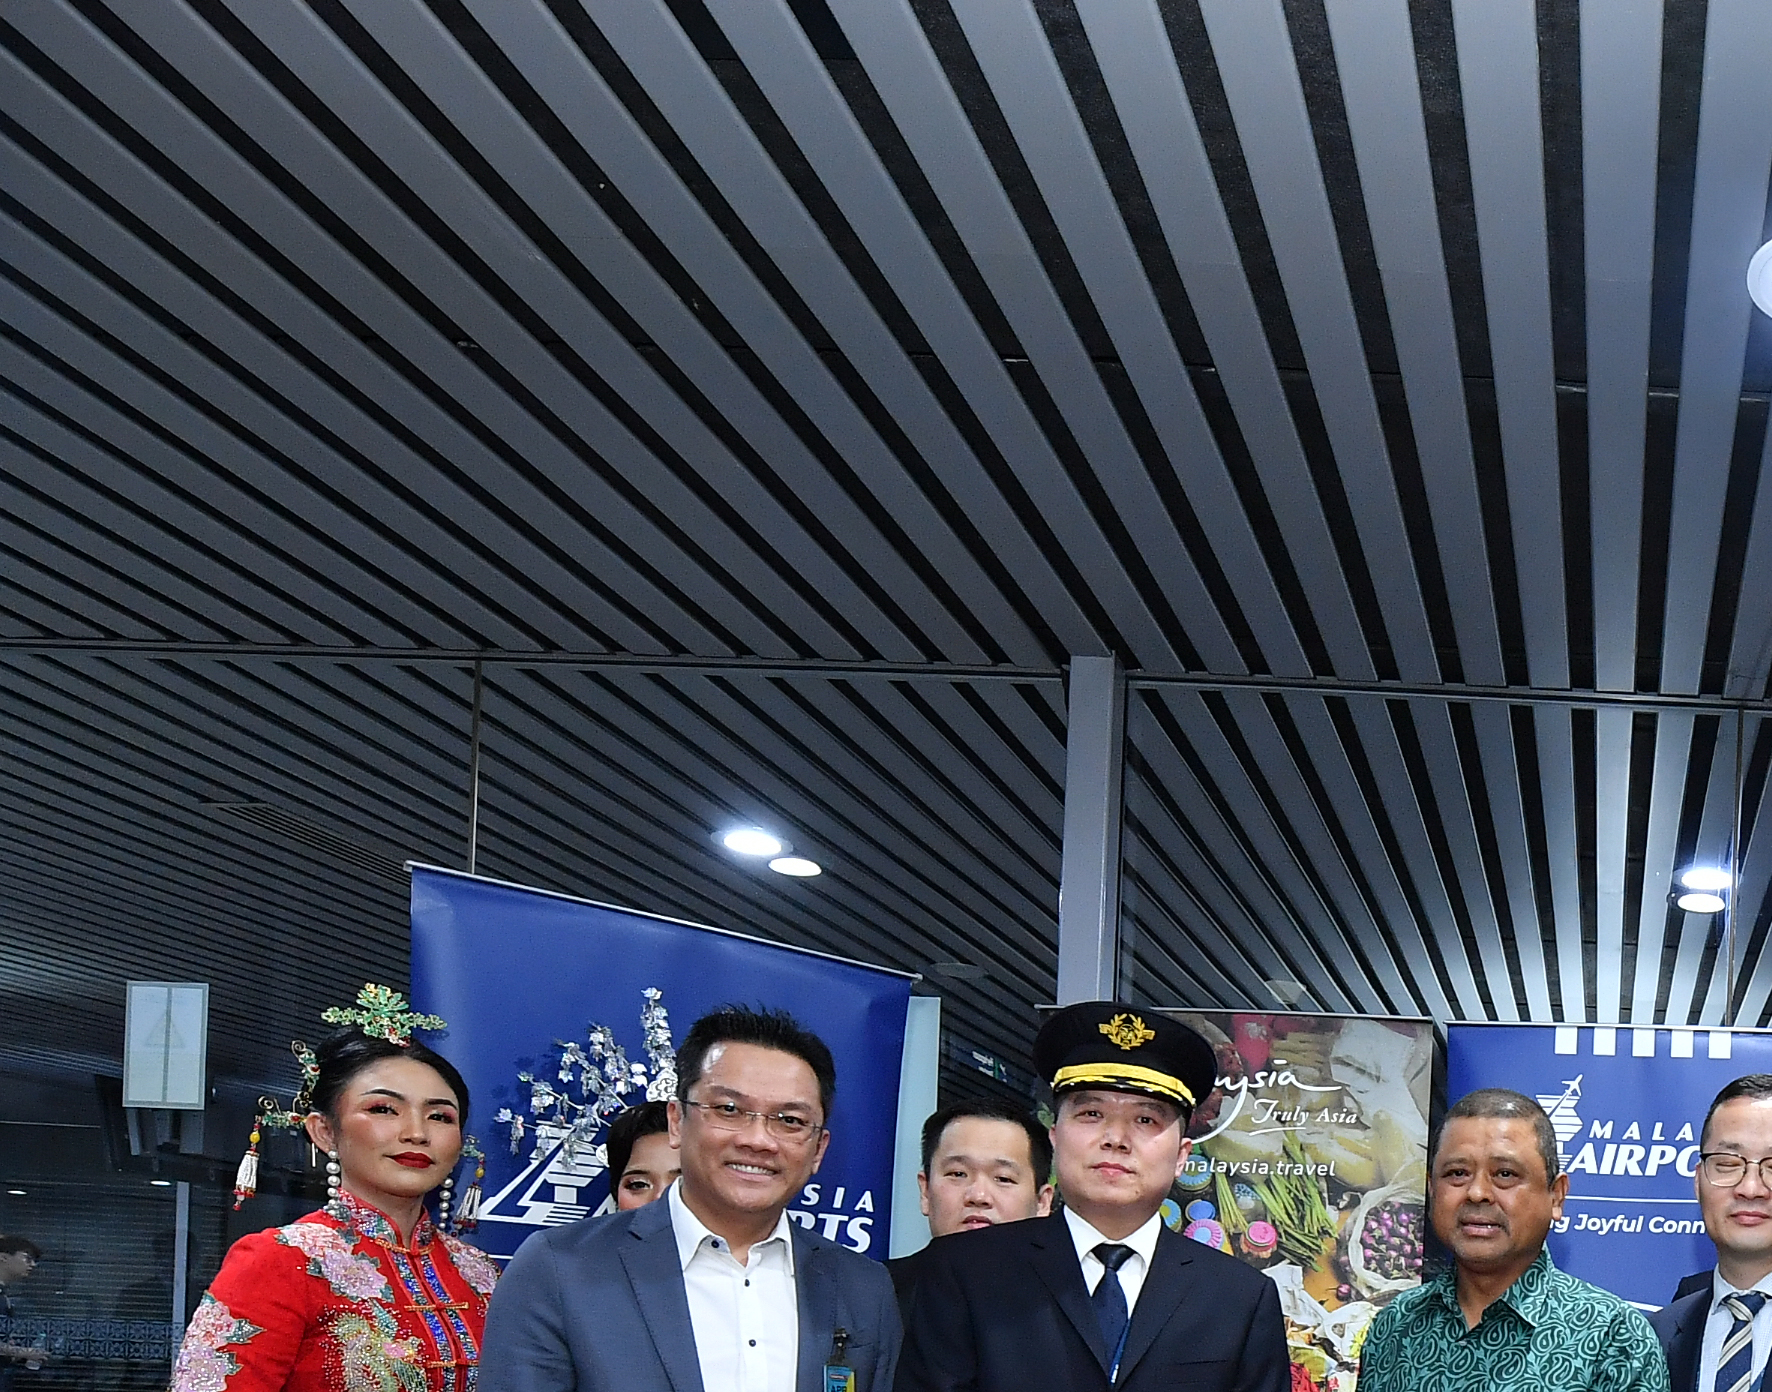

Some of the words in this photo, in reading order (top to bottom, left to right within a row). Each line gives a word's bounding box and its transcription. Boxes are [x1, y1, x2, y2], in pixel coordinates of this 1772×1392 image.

[1250, 1099, 1309, 1126] Truly
[1315, 1107, 1358, 1125] Asia
[1588, 1119, 1694, 1142] MALA
[1566, 1142, 1701, 1178] AIRPO
[800, 1183, 875, 1213] SIA
[1573, 1213, 1643, 1235] Joyful
[1654, 1216, 1706, 1234] Conn
